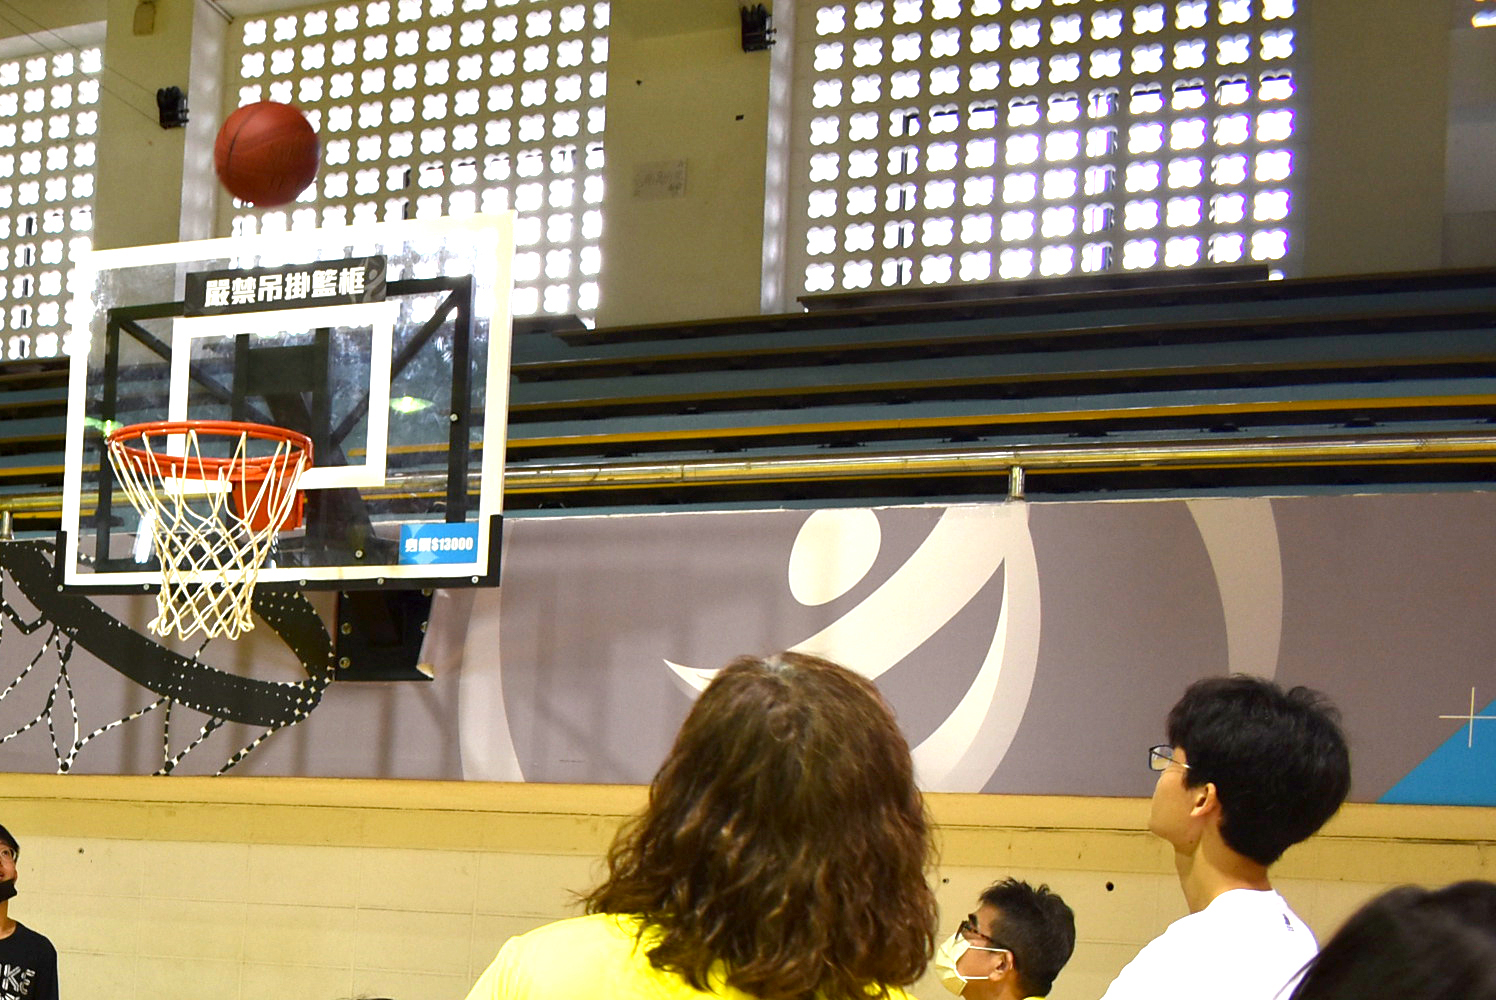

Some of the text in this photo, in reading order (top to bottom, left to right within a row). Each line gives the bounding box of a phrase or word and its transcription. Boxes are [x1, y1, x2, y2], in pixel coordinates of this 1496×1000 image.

[204, 267, 364, 307] 嚴禁吊掛籃框
